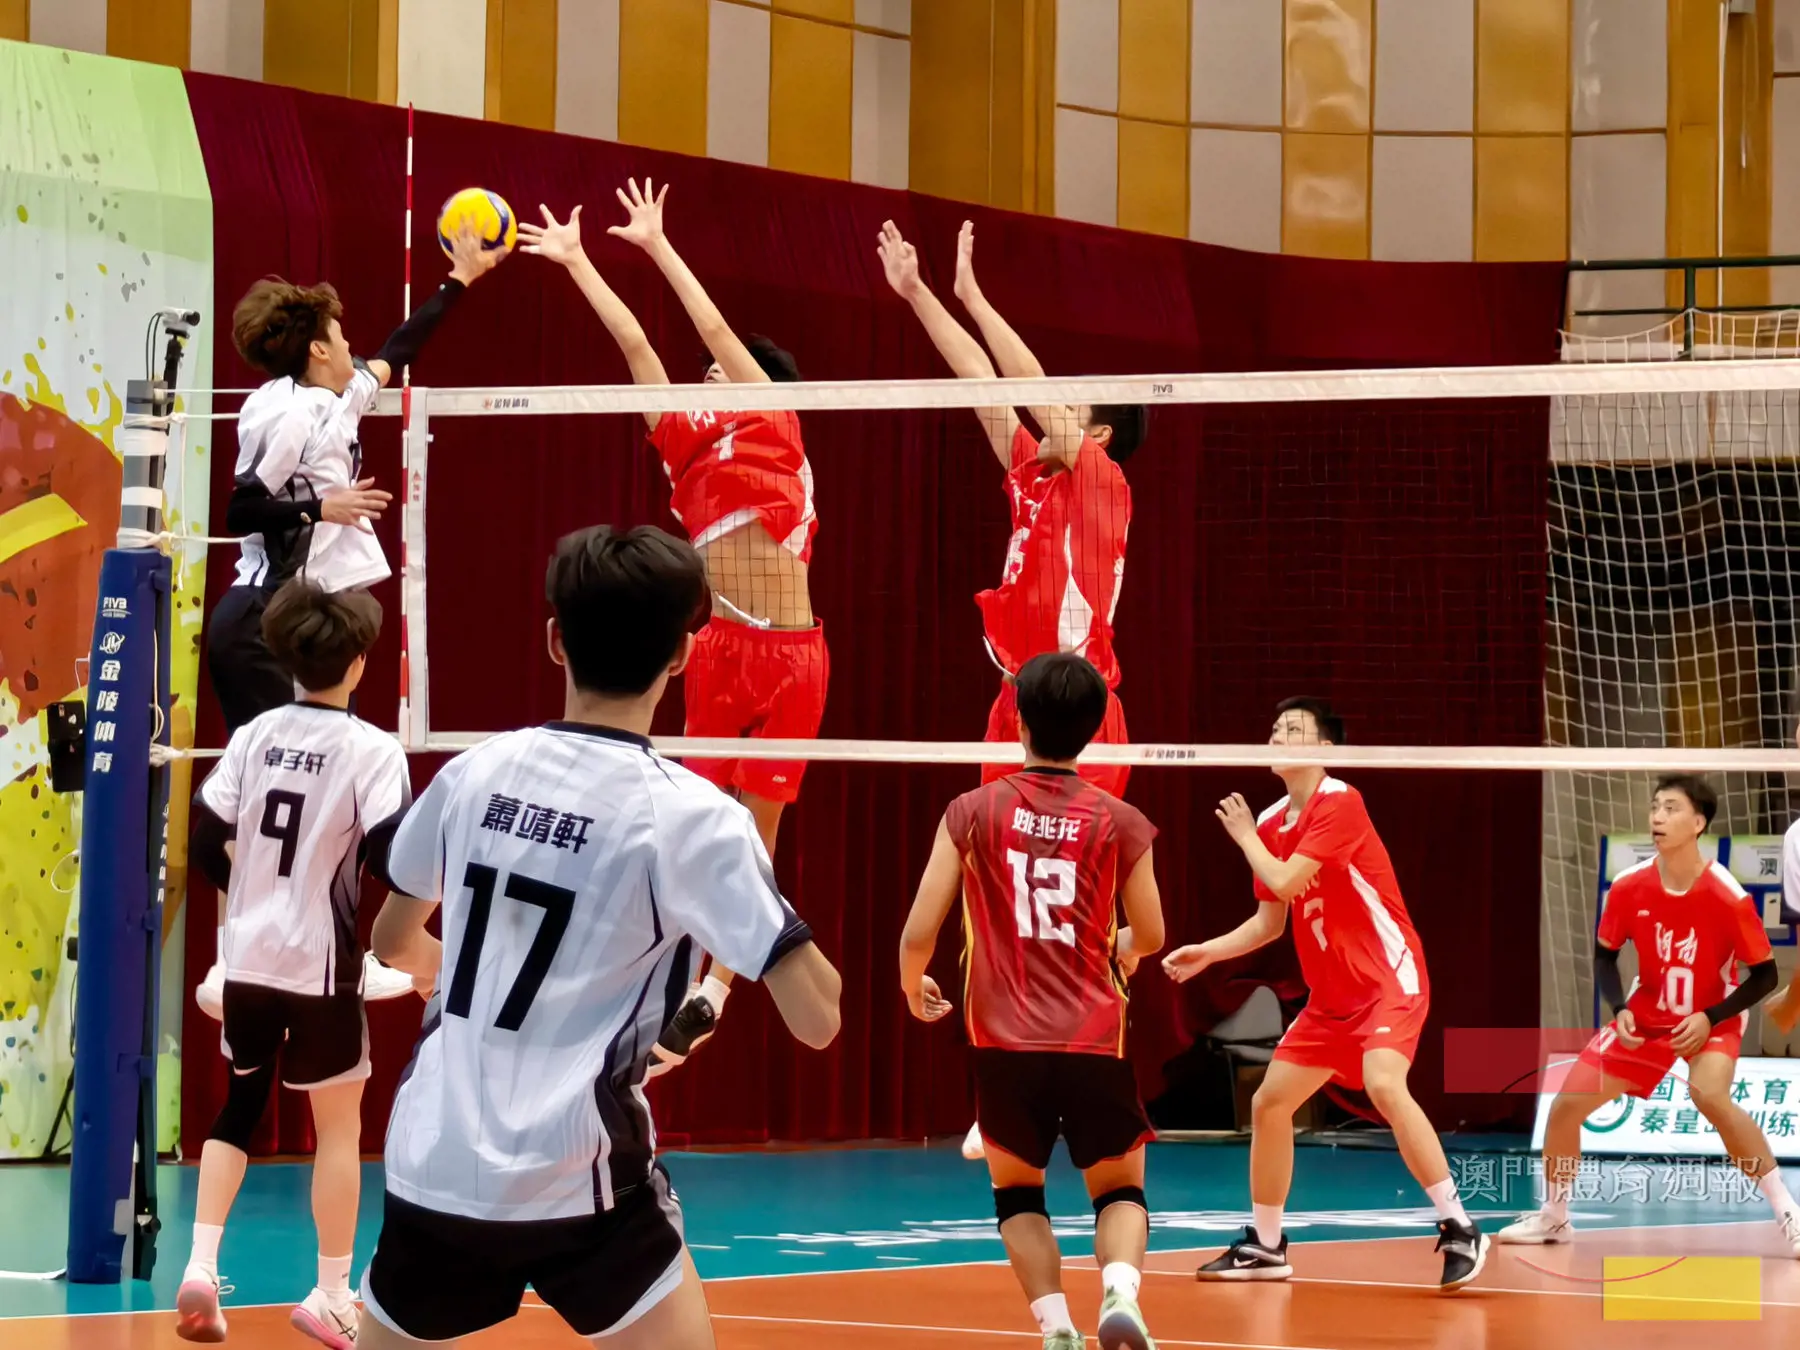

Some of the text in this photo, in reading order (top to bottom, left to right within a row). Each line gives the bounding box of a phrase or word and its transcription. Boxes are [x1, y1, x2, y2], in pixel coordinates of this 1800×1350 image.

[103, 597, 127, 609] FIVB
[264, 746, 327, 776] 卓子轩
[260, 788, 306, 878] 9
[480, 793, 595, 854] 蕭靖軒
[1006, 848, 1077, 948] 12
[445, 861, 577, 1032] 17
[1656, 966, 1695, 1016] 10
